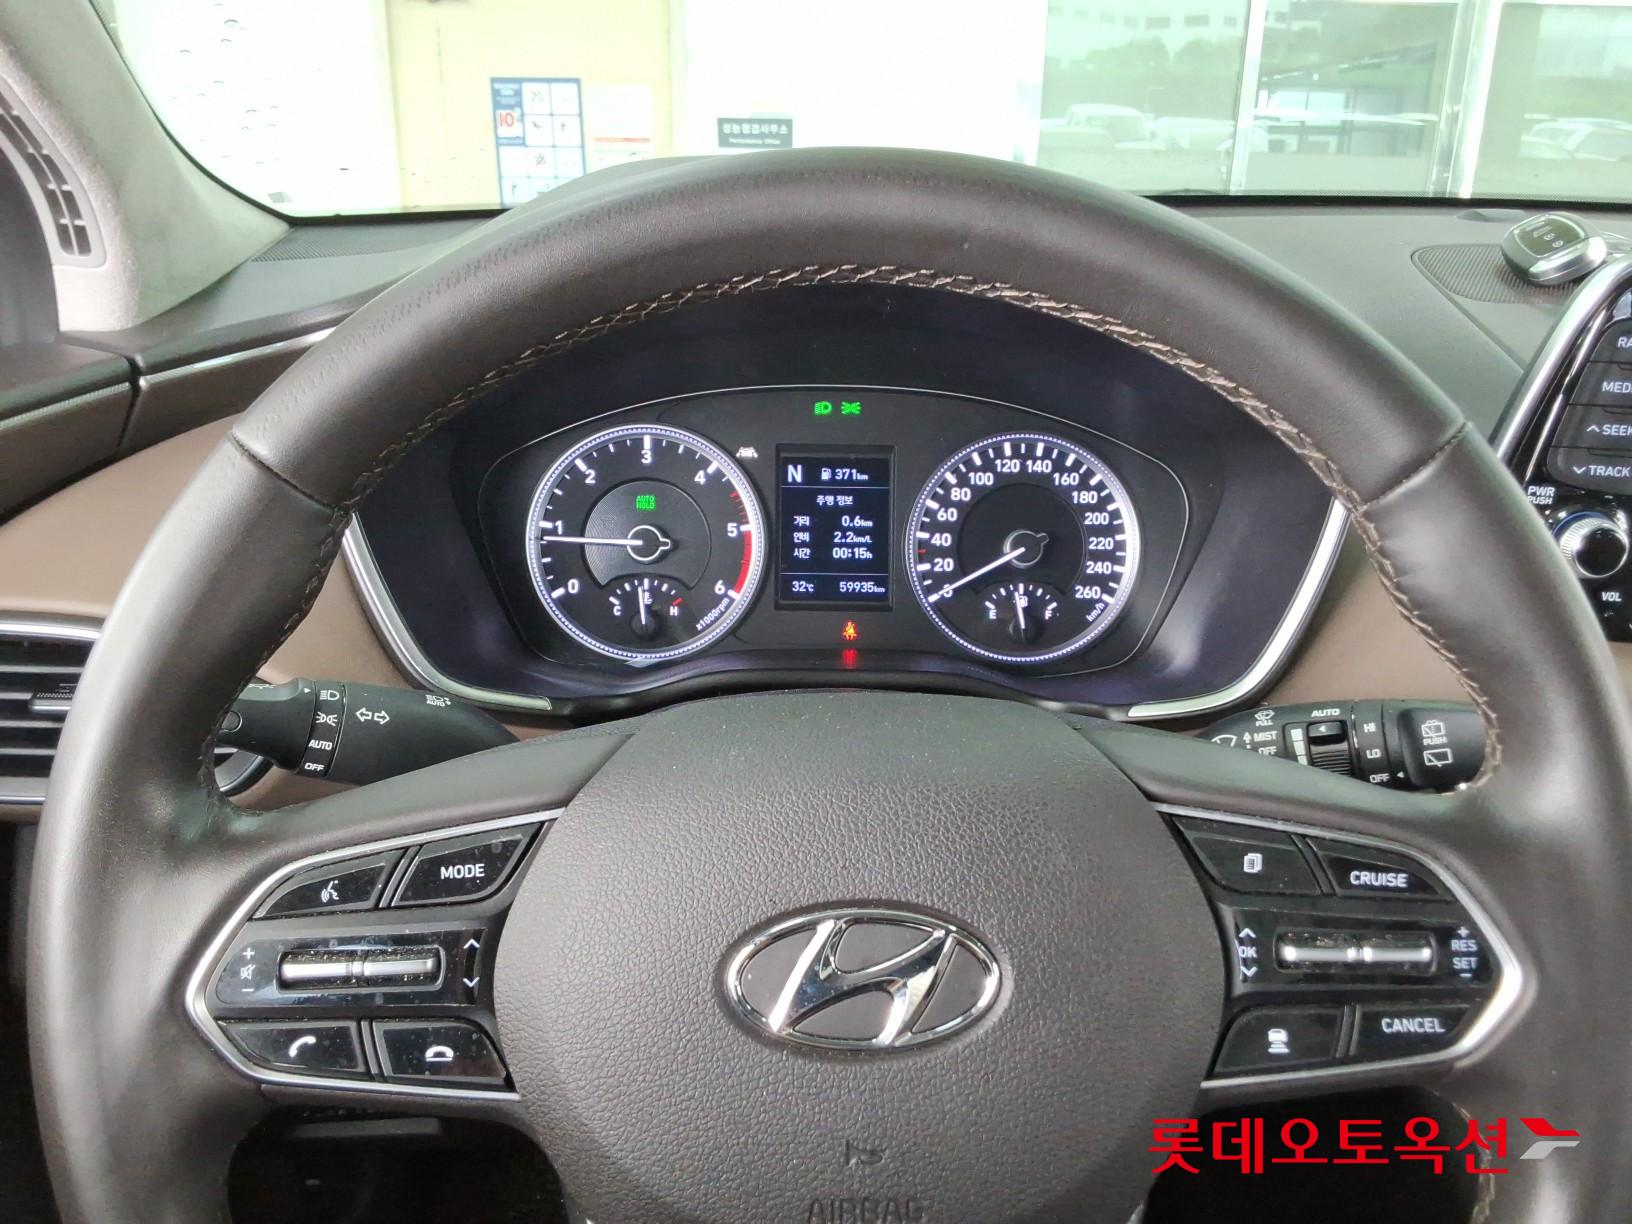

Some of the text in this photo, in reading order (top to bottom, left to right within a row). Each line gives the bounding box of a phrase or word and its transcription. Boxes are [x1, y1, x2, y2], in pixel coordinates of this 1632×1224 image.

[1603, 382, 1632, 393] MED
[641, 449, 652, 464] 3
[995, 459, 1021, 472] 120
[1026, 460, 1052, 473] 140
[1589, 465, 1630, 477] TRACK
[584, 470, 596, 484] 2
[694, 471, 706, 484] 4
[788, 465, 802, 483] N
[835, 469, 868, 480] 371km
[968, 472, 994, 485] 100
[1053, 472, 1079, 486] 160
[951, 487, 971, 501] 80
[1072, 491, 1098, 503] 180
[1527, 486, 1556, 496] PWR
[816, 495, 853, 506] 주행 정보
[1527, 496, 1552, 505] PUSH
[937, 507, 958, 522] 60
[1084, 512, 1109, 525] 200
[794, 516, 810, 526] 거리
[842, 515, 873, 528] 0.6km
[555, 520, 564, 535] 1
[728, 523, 738, 538] 5
[794, 532, 809, 543] 연비
[834, 531, 872, 544] 2.2km/L
[930, 534, 952, 547] 40
[1089, 537, 1114, 550] 220
[793, 548, 811, 558] 시간
[833, 547, 872, 559] 00:15h
[933, 558, 954, 571] 20
[1086, 561, 1112, 574] 240
[568, 579, 579, 594] 0
[714, 580, 726, 594] 6
[840, 581, 885, 592] 59935km
[1074, 586, 1100, 600] 260
[1602, 592, 1621, 601] VOL
[613, 606, 622, 616] C
[670, 606, 678, 616] H
[989, 609, 996, 620] E
[1045, 609, 1052, 619] F
[1086, 602, 1105, 622] km/h
[426, 699, 446, 707] AUTO
[1312, 709, 1340, 717] AUTO
[1364, 723, 1376, 732] HI
[1254, 731, 1277, 741] MIST
[1423, 735, 1447, 745] PUSH
[309, 740, 332, 750] AUTO
[1366, 749, 1381, 758] LO
[305, 763, 324, 771] OFF
[1369, 773, 1389, 784] OFF
[441, 864, 485, 879] MODE
[1350, 871, 1408, 887] CRUISE
[1451, 939, 1477, 951] RES
[1238, 945, 1258, 959] OK
[1453, 957, 1477, 969] SET
[1382, 1018, 1445, 1033] CANCEL
